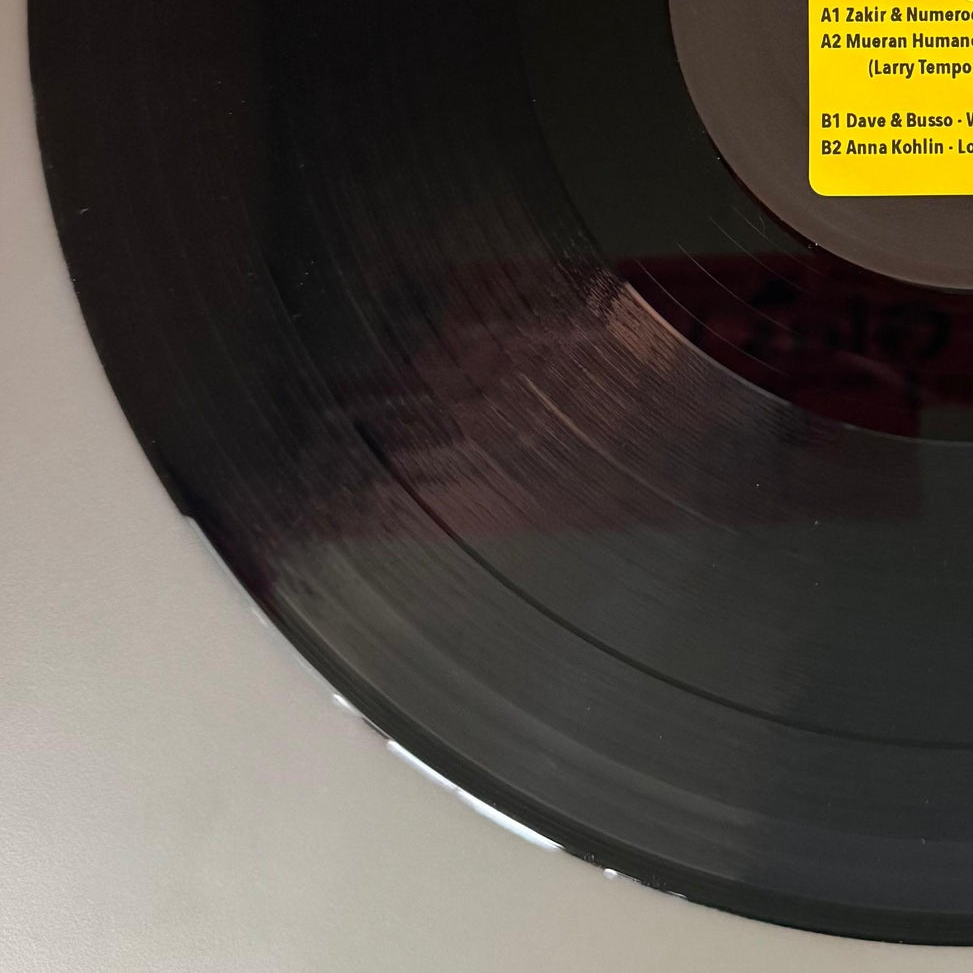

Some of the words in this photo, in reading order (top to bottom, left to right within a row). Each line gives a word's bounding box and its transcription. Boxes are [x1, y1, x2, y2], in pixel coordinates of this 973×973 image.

[820, 7, 839, 23] A1
[845, 6, 887, 23] Zakir
[890, 7, 903, 22] &
[820, 33, 842, 49] A2
[846, 33, 907, 49] Mueran
[868, 58, 915, 79] (Larry
[917, 59, 972, 79] Tempo
[821, 112, 840, 129] B1
[846, 112, 887, 128] Dave
[890, 112, 903, 128] &
[906, 112, 953, 128] Busso
[821, 139, 842, 155] B2
[846, 139, 888, 155] Anna
[891, 137, 944, 155] Kohlin
